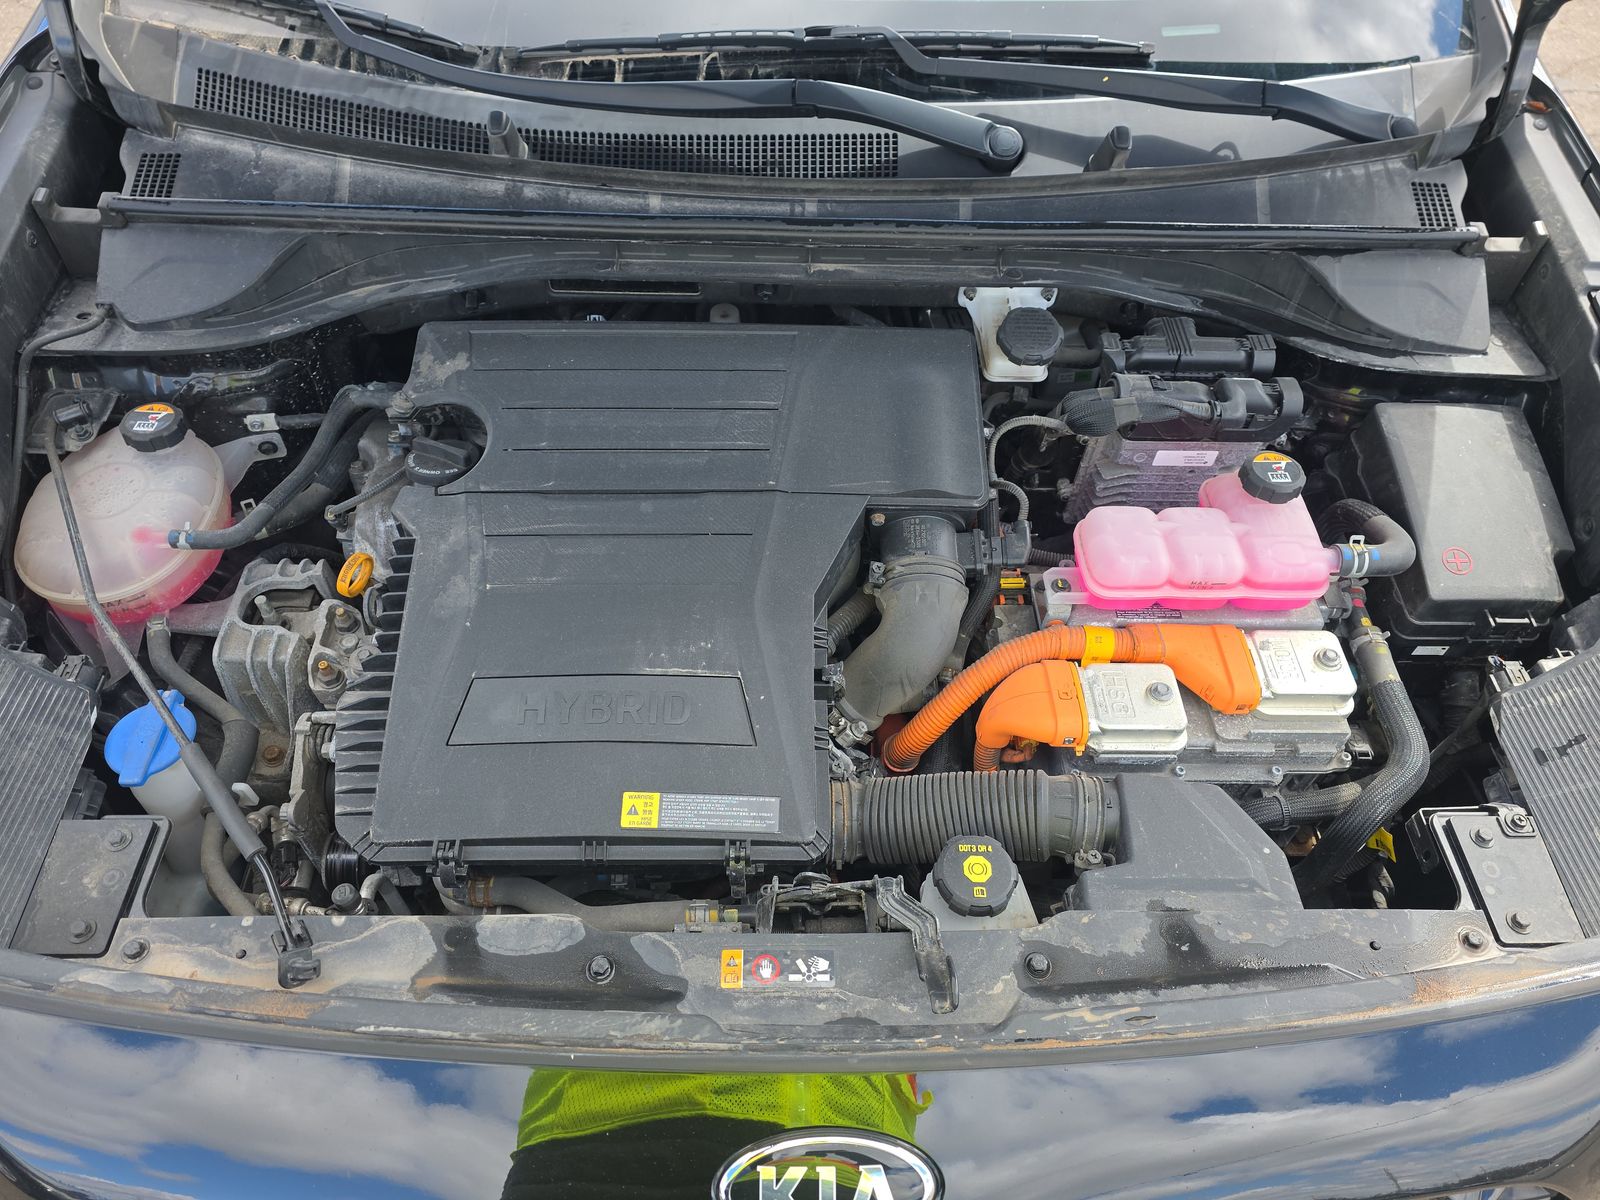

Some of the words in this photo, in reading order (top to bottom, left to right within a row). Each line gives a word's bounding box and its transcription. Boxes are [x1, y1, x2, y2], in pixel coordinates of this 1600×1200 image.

[516, 690, 692, 726] HYBRID
[1102, 671, 1129, 715] HSG
[757, 1164, 895, 1200] KIA
